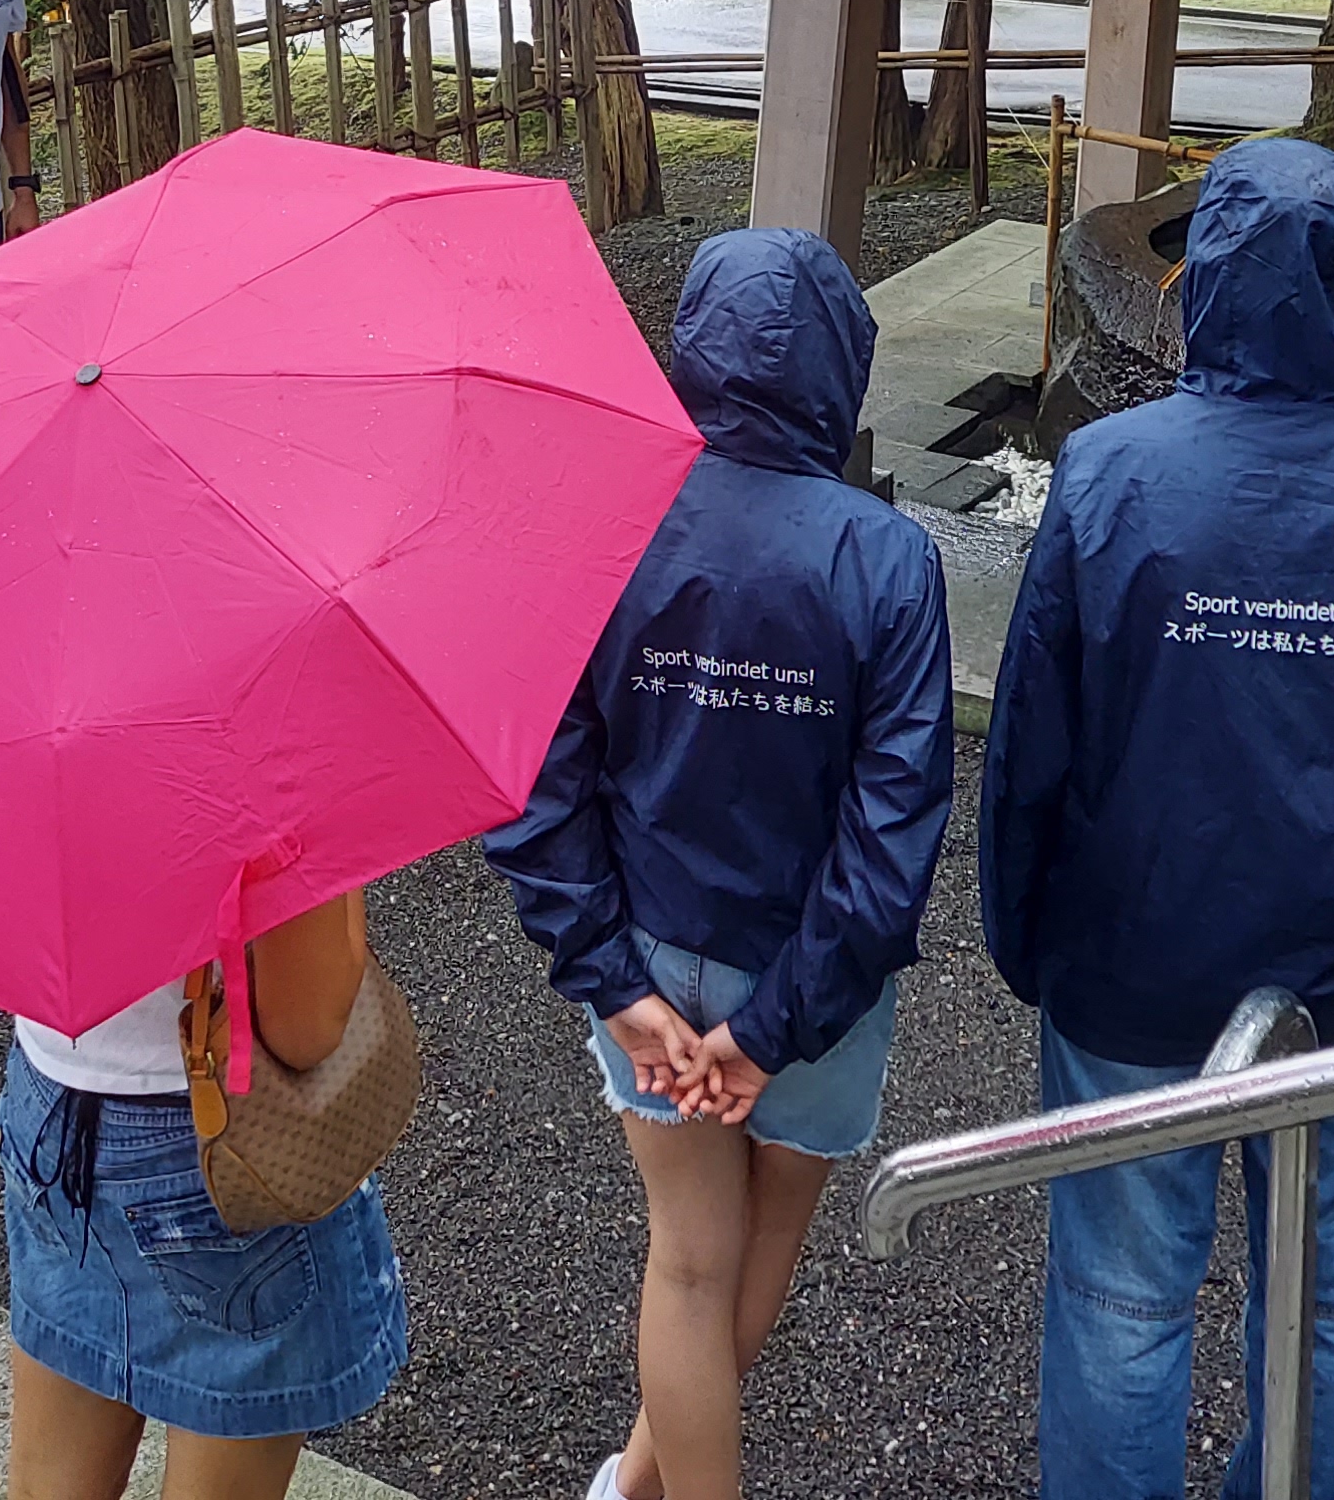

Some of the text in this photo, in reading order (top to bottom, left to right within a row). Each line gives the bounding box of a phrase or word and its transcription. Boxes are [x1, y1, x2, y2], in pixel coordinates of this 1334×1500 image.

[1184, 591, 1240, 615] Sport
[642, 647, 815, 686] Sport verbindet uns!
[630, 675, 836, 716] スポーツは私たちを結ぶ
